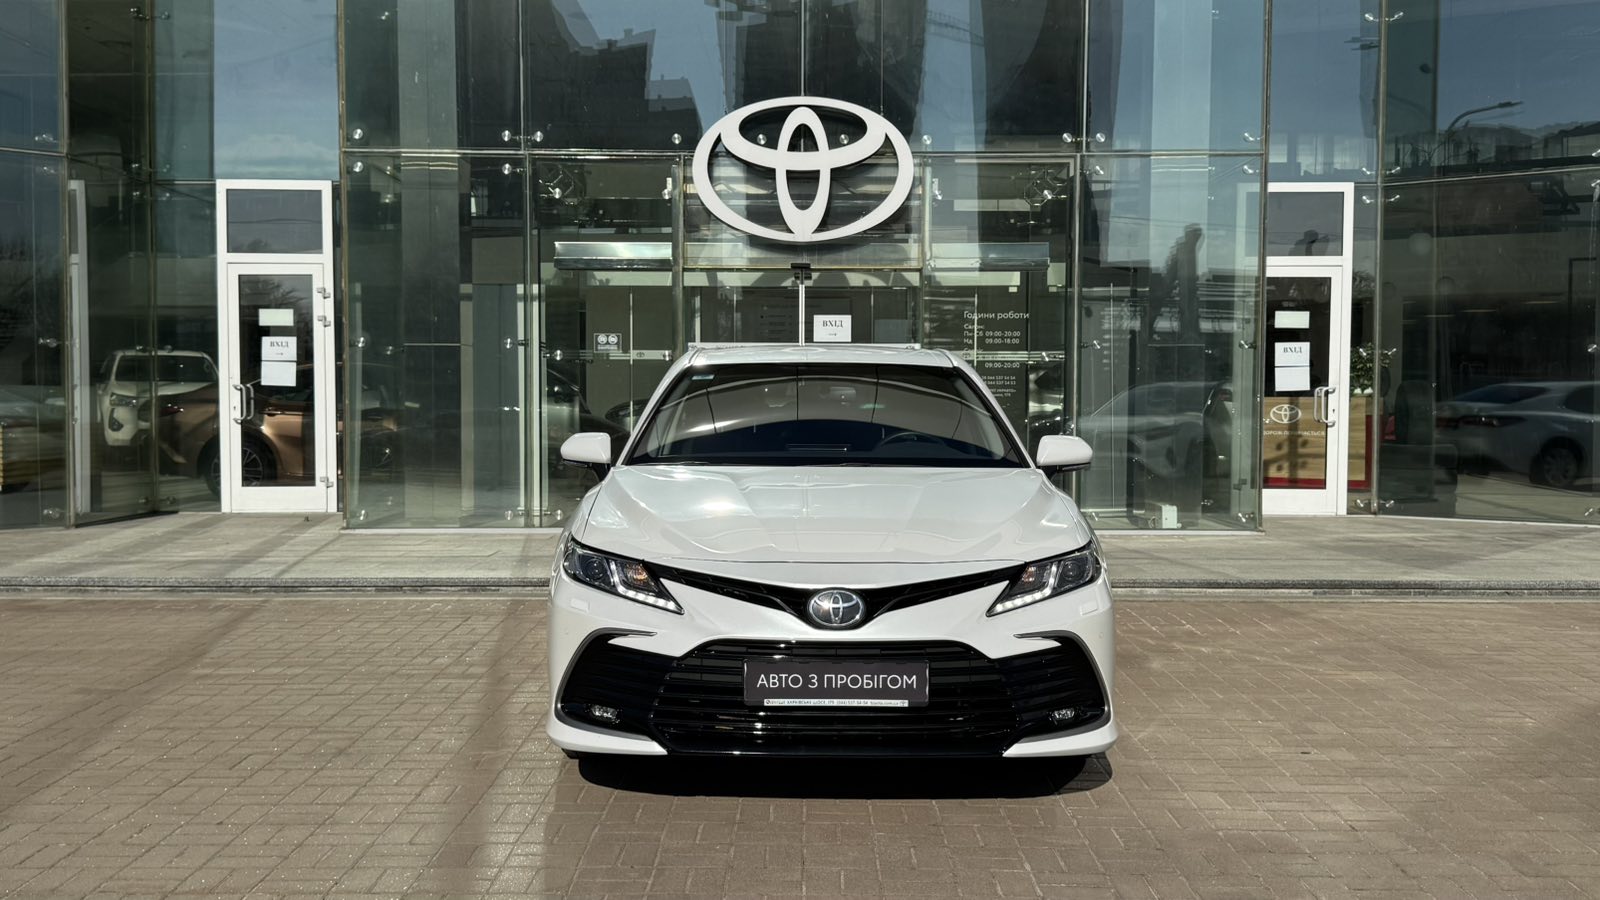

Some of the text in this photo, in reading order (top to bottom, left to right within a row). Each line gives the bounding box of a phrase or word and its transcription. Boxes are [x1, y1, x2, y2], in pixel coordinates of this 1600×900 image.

[963, 310, 1030, 320] Години роботи
[822, 320, 844, 328] ВХІД
[756, 674, 916, 689] АВТО З ПРОБІГОМ
